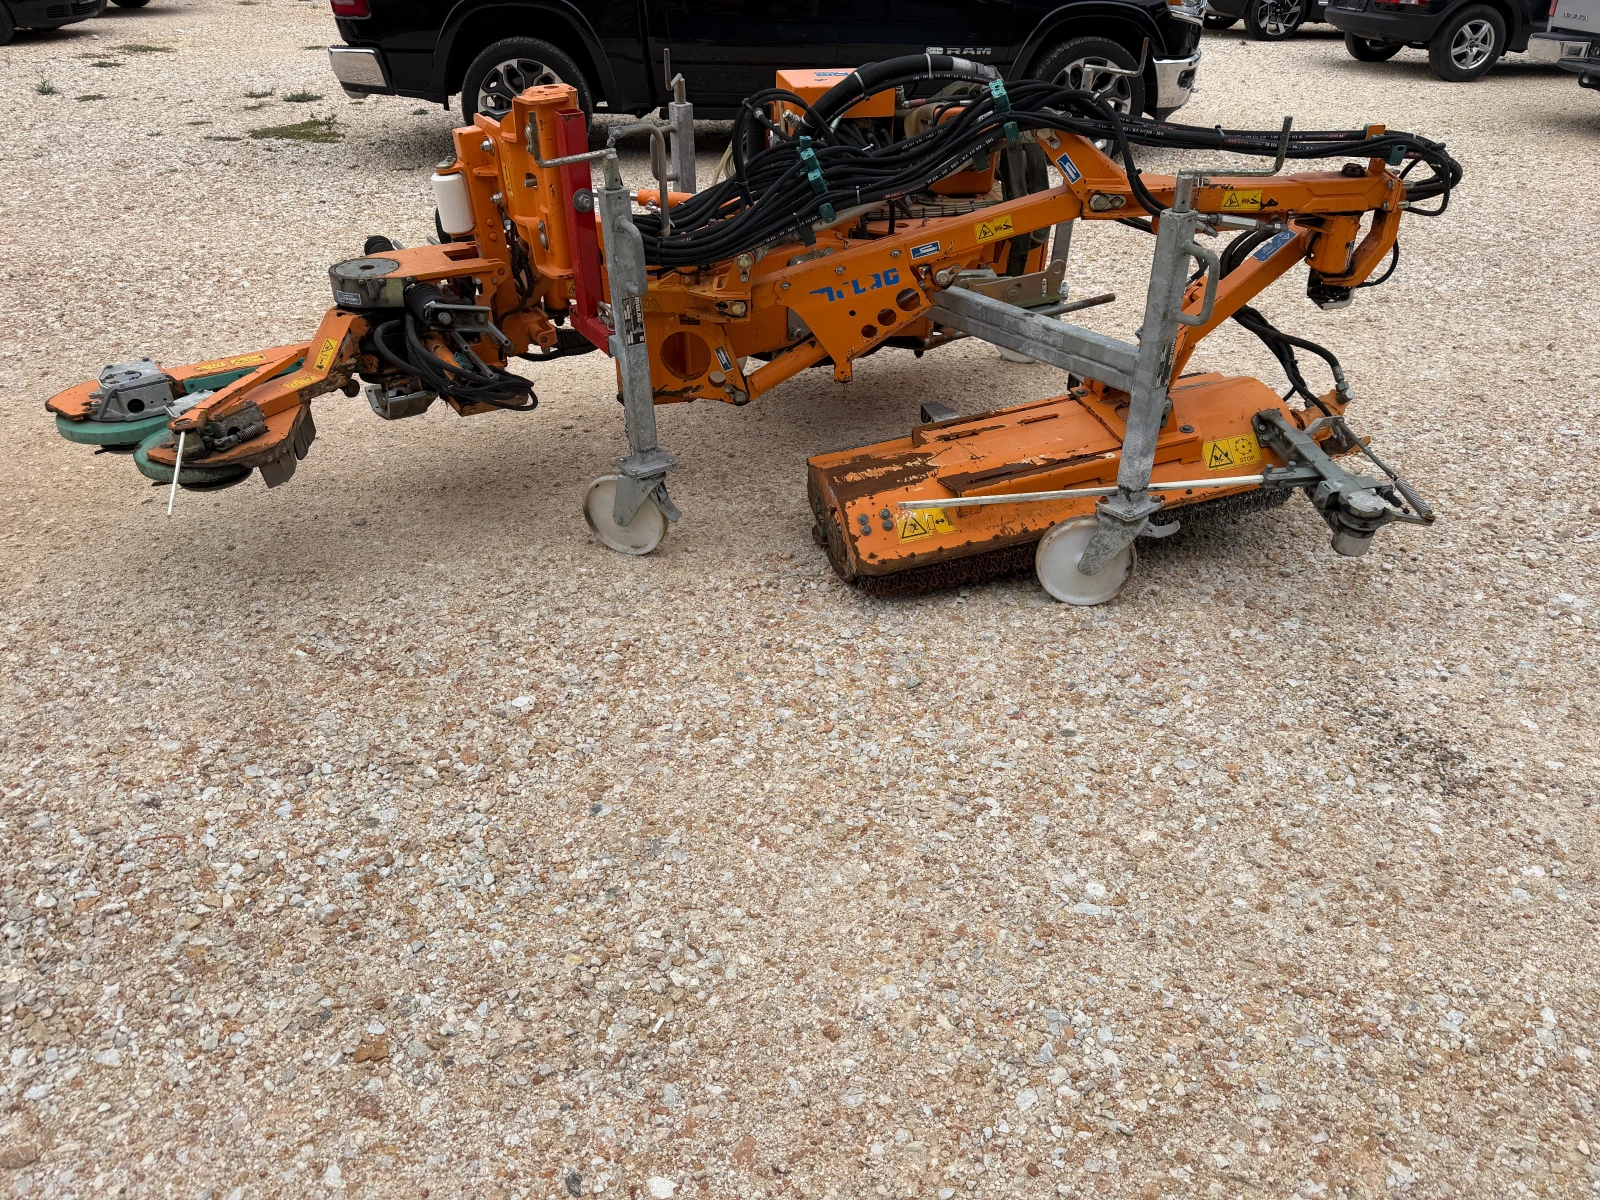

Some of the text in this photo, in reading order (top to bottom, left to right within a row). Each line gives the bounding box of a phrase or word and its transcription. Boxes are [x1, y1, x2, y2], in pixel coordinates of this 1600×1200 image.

[946, 47, 992, 55] RAM
[809, 267, 900, 302] LAG
[1239, 455, 1255, 463] STOP
